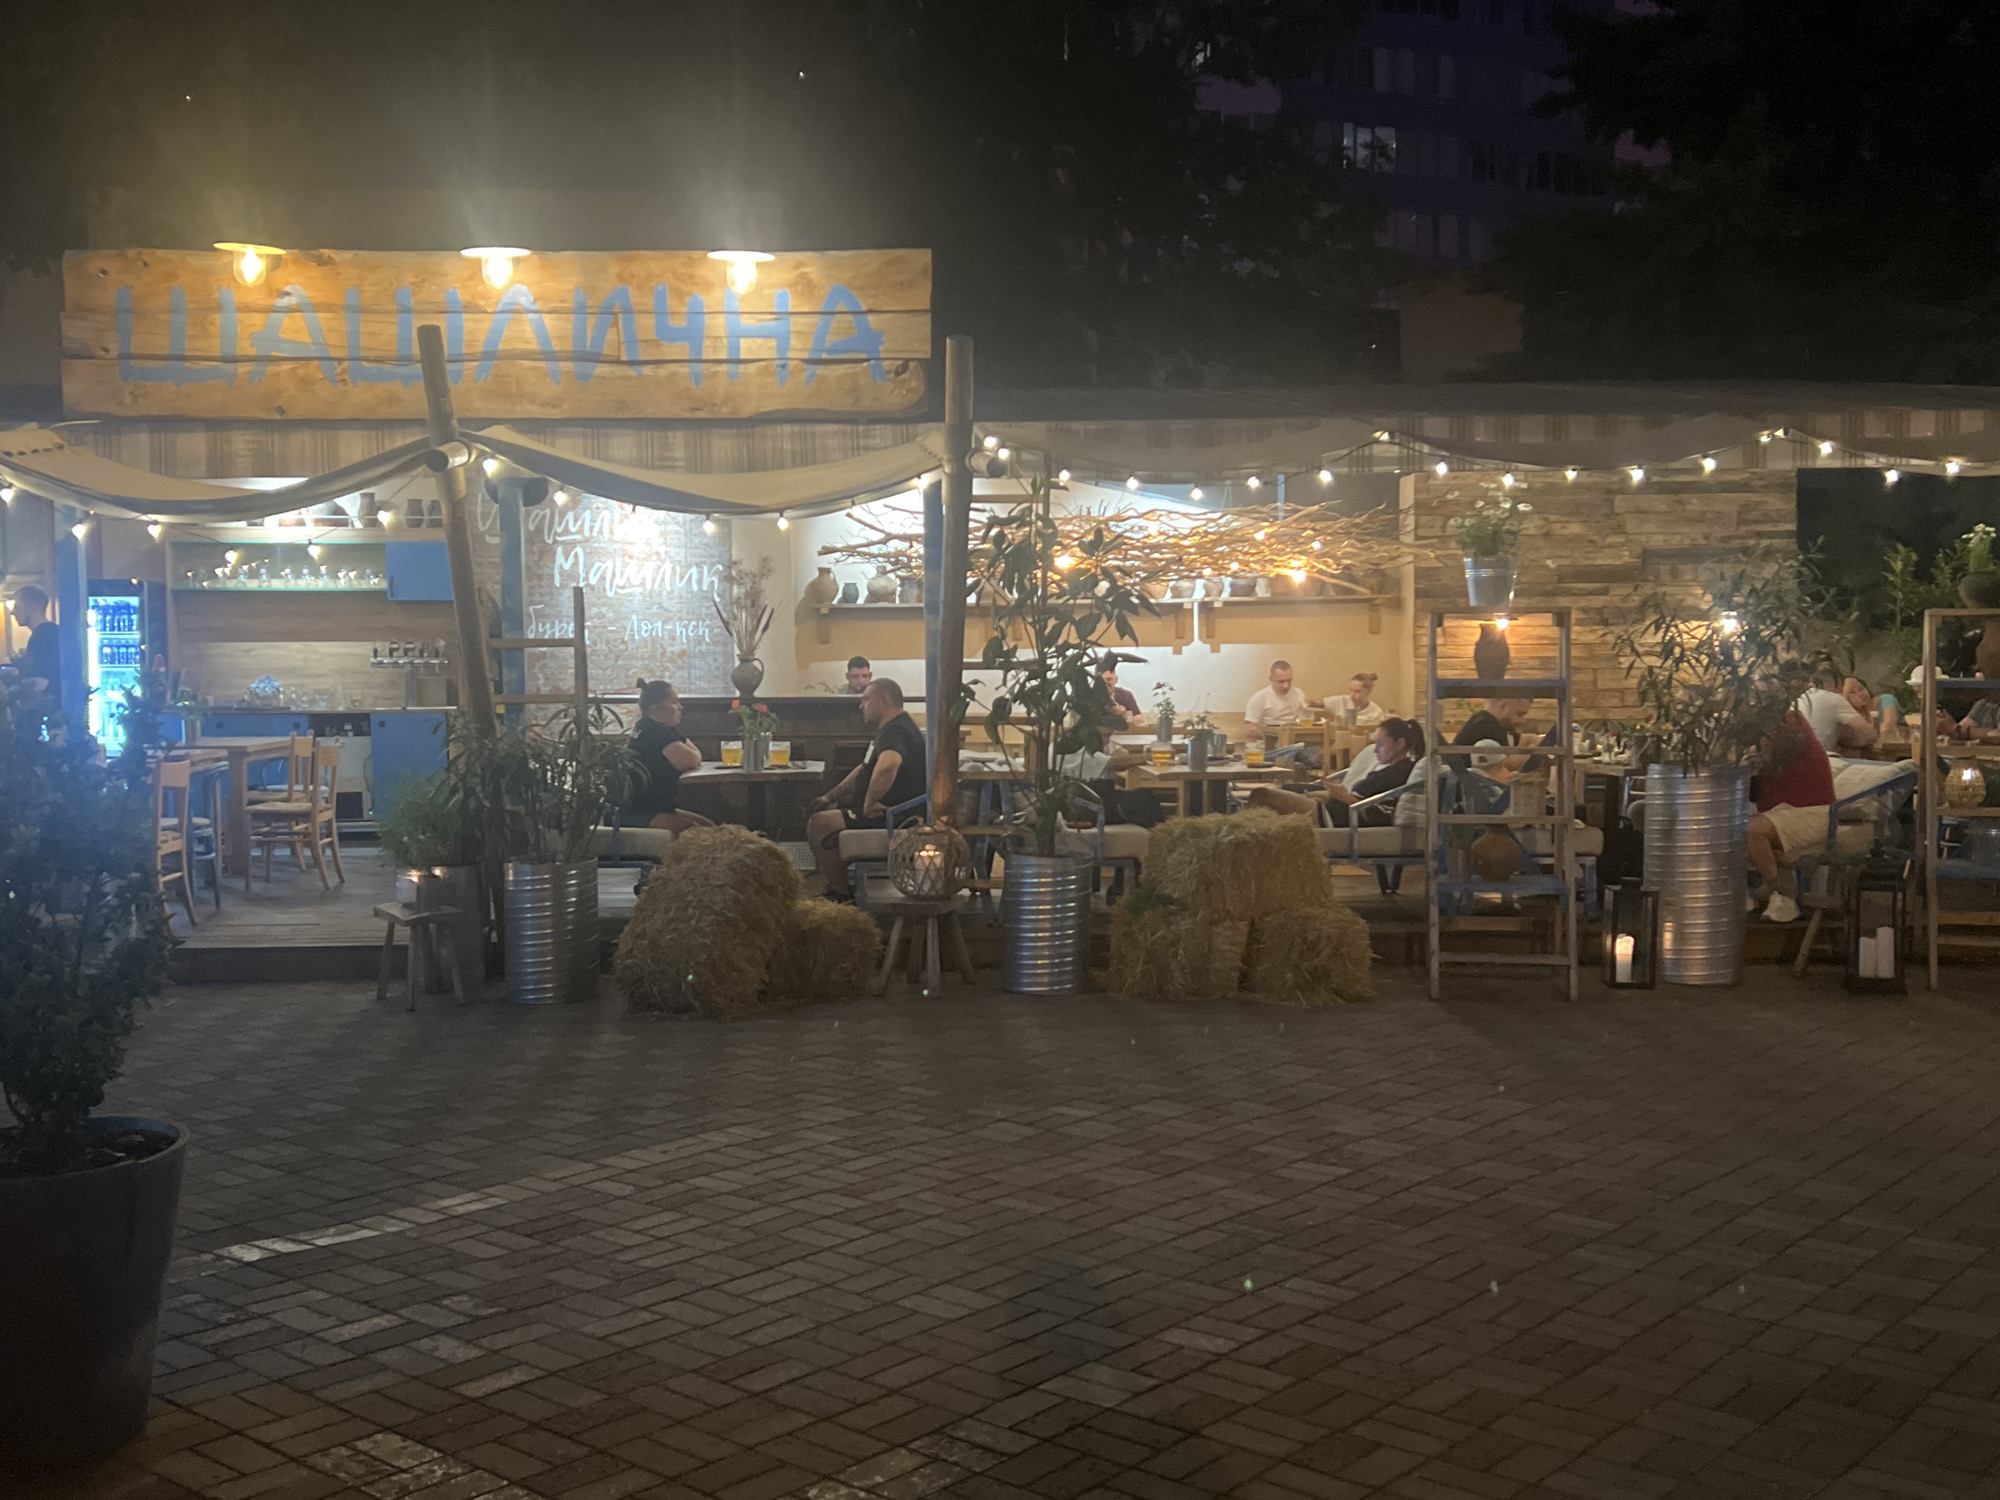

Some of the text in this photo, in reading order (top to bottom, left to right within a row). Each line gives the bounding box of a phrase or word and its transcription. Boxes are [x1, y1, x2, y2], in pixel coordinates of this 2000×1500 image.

[115, 284, 887, 388] ШАШЛИЧНА
[477, 491, 668, 545] Шашл
[553, 545, 724, 602] Машлик
